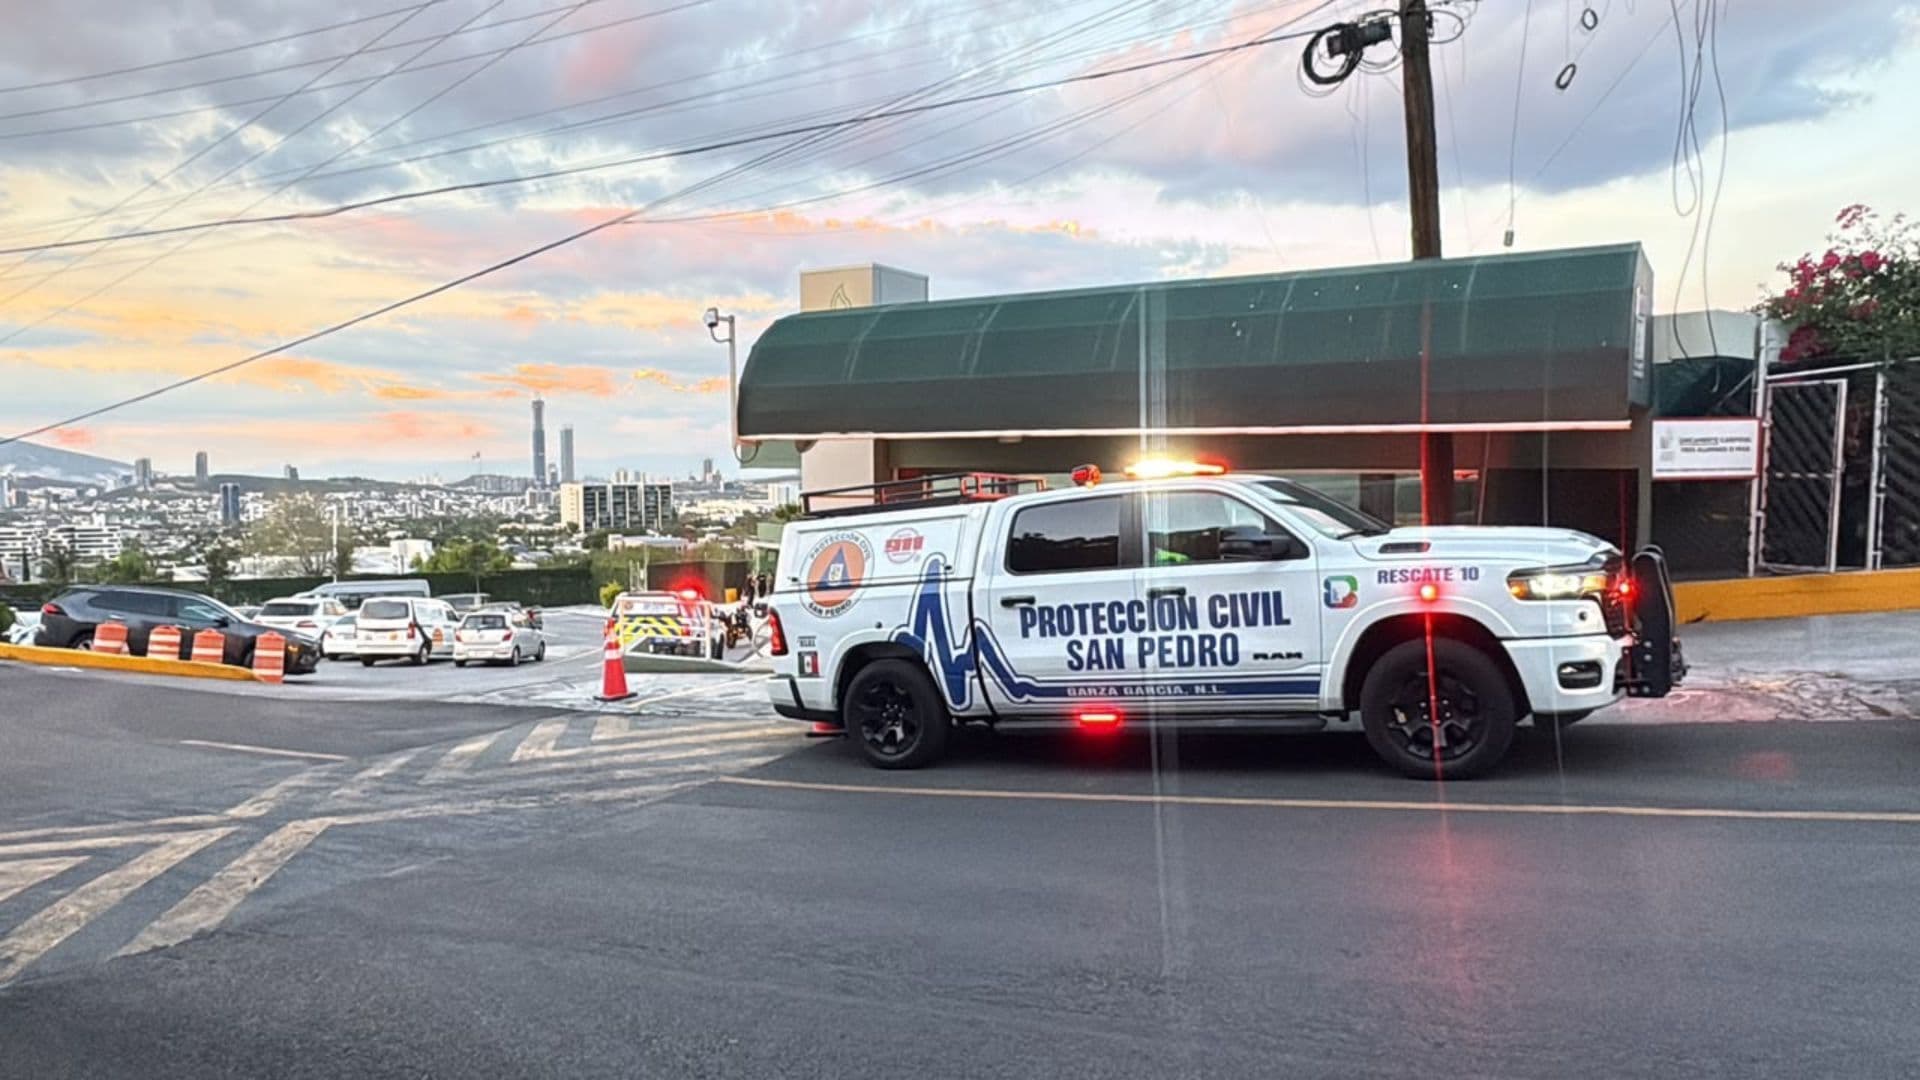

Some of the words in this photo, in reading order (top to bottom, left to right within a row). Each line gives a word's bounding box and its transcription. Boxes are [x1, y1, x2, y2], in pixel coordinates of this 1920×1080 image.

[884, 536, 924, 553] 911
[1377, 566, 1455, 585] RESCATE
[1460, 566, 1480, 582] 10
[1207, 590, 1292, 630] CIVIL
[1066, 638, 1126, 672] SAN
[1137, 632, 1241, 669] PEDRO
[1252, 651, 1303, 661] RAM
[1066, 686, 1119, 698] GARZA
